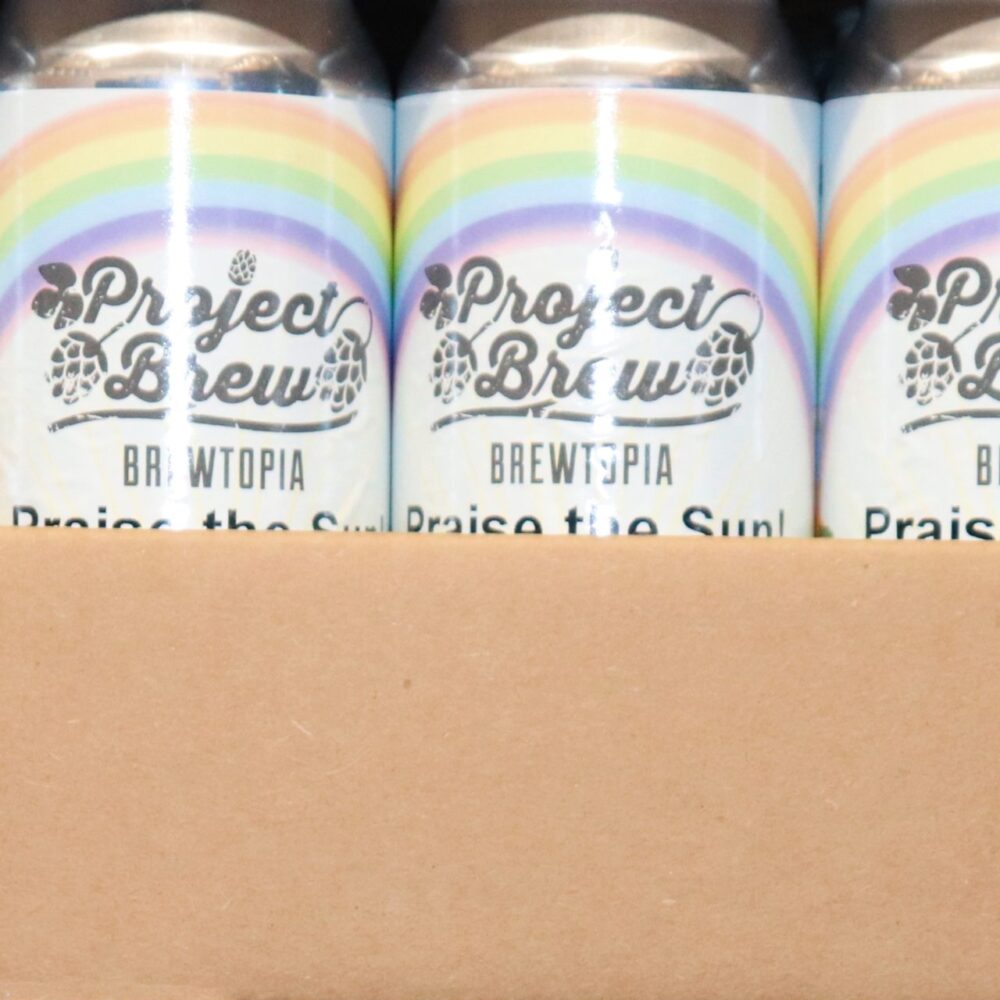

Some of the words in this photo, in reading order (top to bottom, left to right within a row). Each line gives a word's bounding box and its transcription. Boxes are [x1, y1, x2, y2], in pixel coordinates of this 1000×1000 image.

[457, 255, 714, 349] Project
[104, 331, 316, 407] Brew
[123, 444, 305, 491] BRWTOPIA
